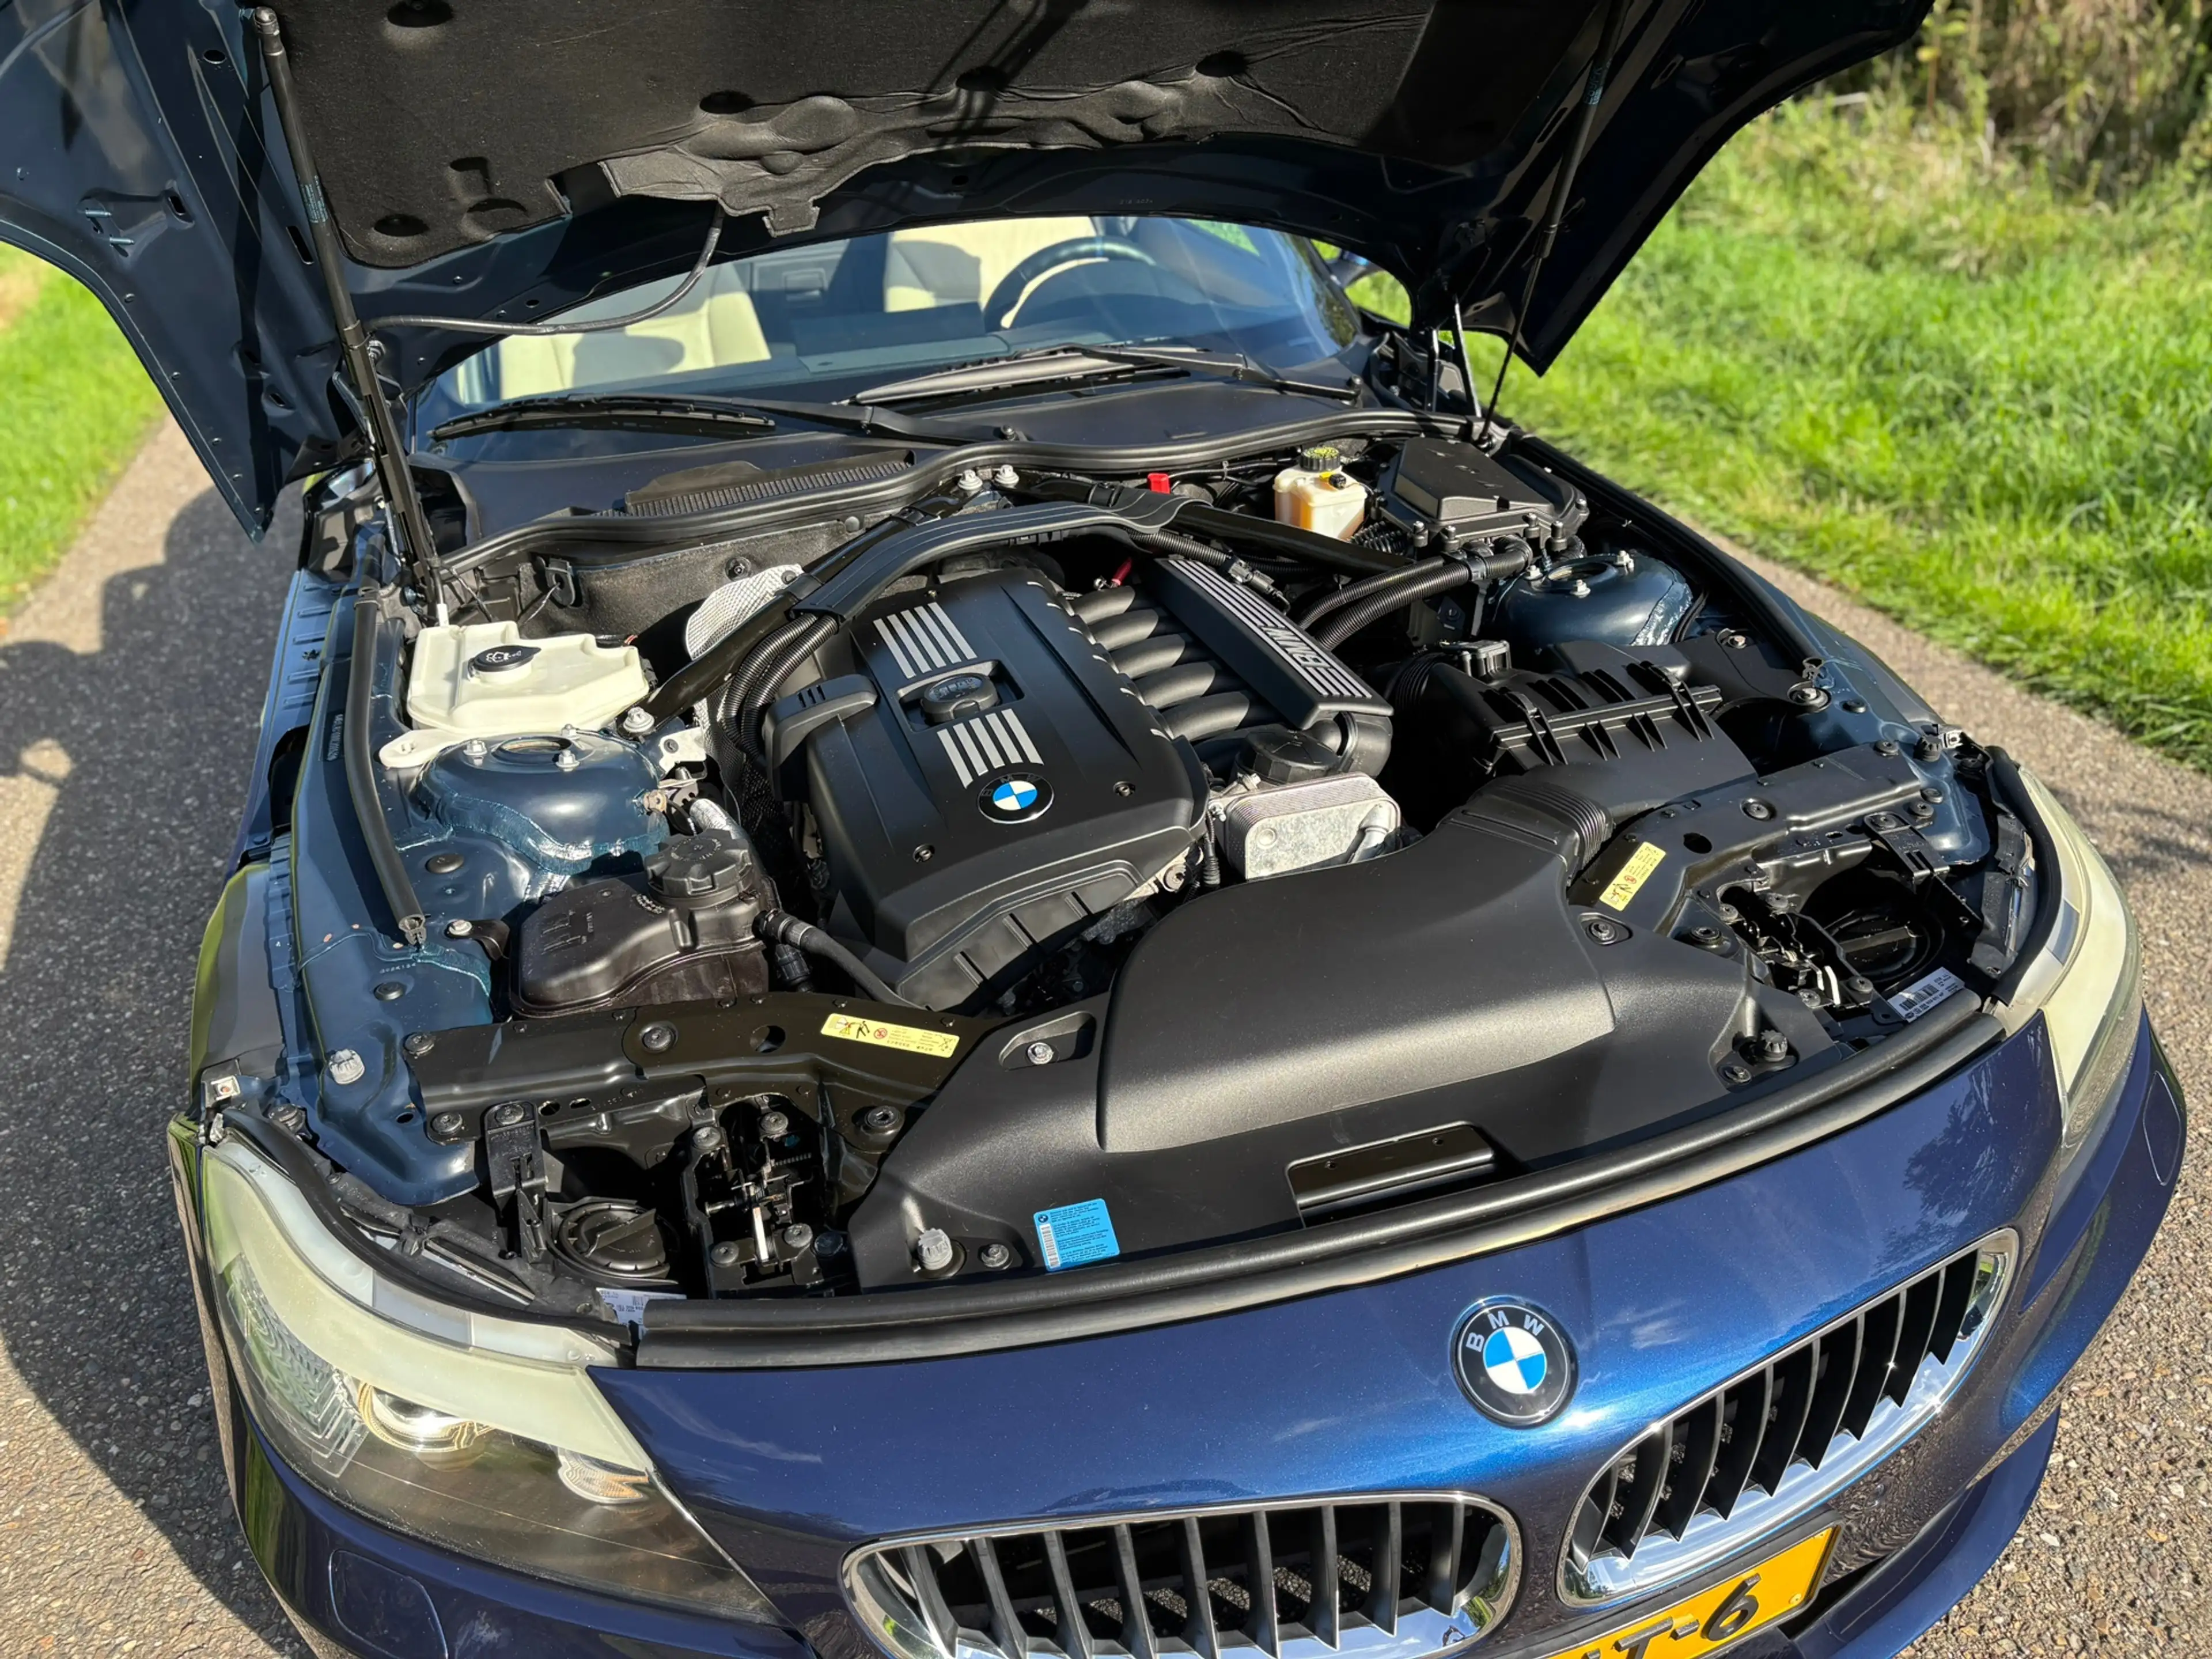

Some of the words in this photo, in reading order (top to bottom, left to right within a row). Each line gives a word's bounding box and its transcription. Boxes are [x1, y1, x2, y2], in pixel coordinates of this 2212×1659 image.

[1260, 626, 1331, 668] BMW
[980, 773, 1041, 797] BMW
[1465, 1309, 1545, 1353] BMW
[1583, 1573, 1762, 1659] T-6
